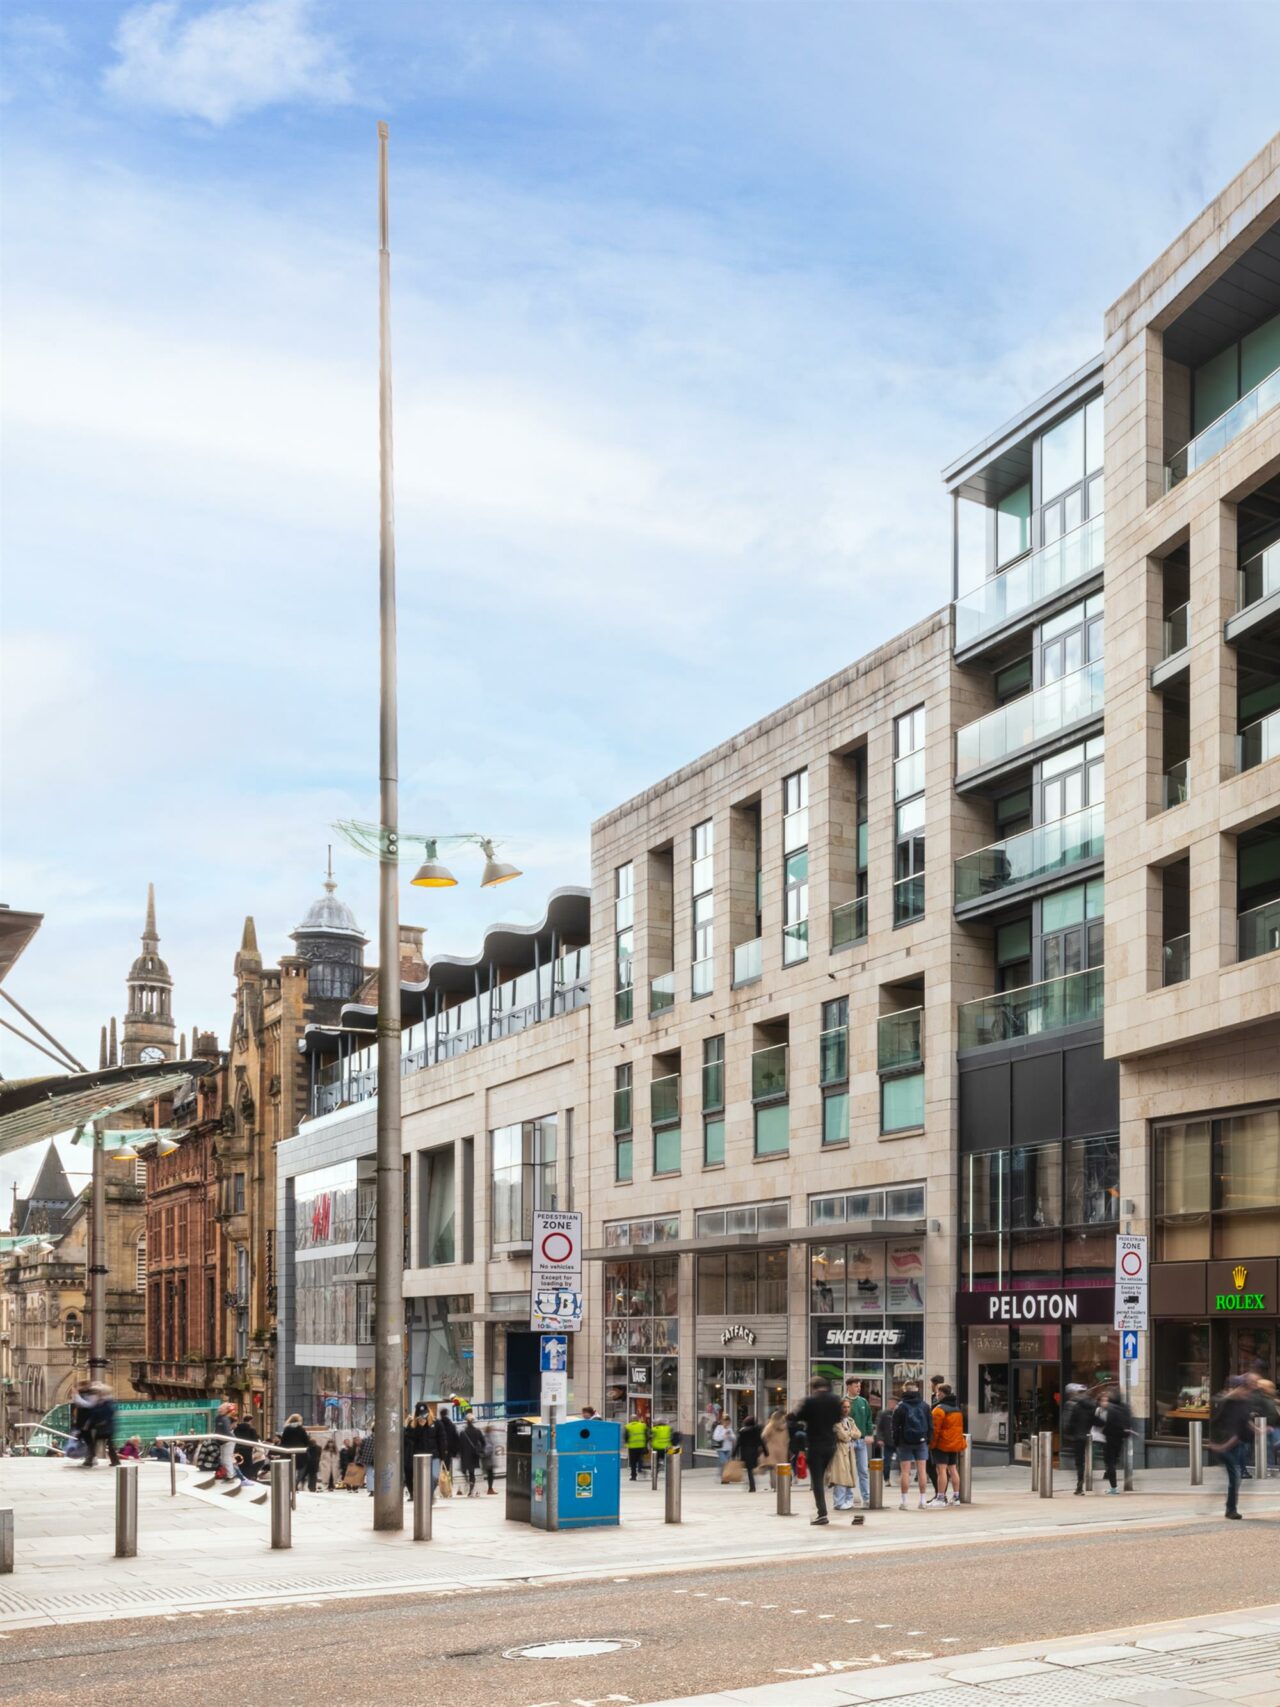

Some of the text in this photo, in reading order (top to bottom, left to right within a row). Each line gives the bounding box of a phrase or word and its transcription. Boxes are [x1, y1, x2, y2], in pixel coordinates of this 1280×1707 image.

[543, 1221, 572, 1229] ZONE
[989, 1294, 1078, 1319] PELOTON
[1215, 1294, 1265, 1310] ROLEX
[720, 1325, 757, 1346] FATFACE
[825, 1329, 901, 1345] SKECHERS
[631, 1367, 647, 1383] VANS
